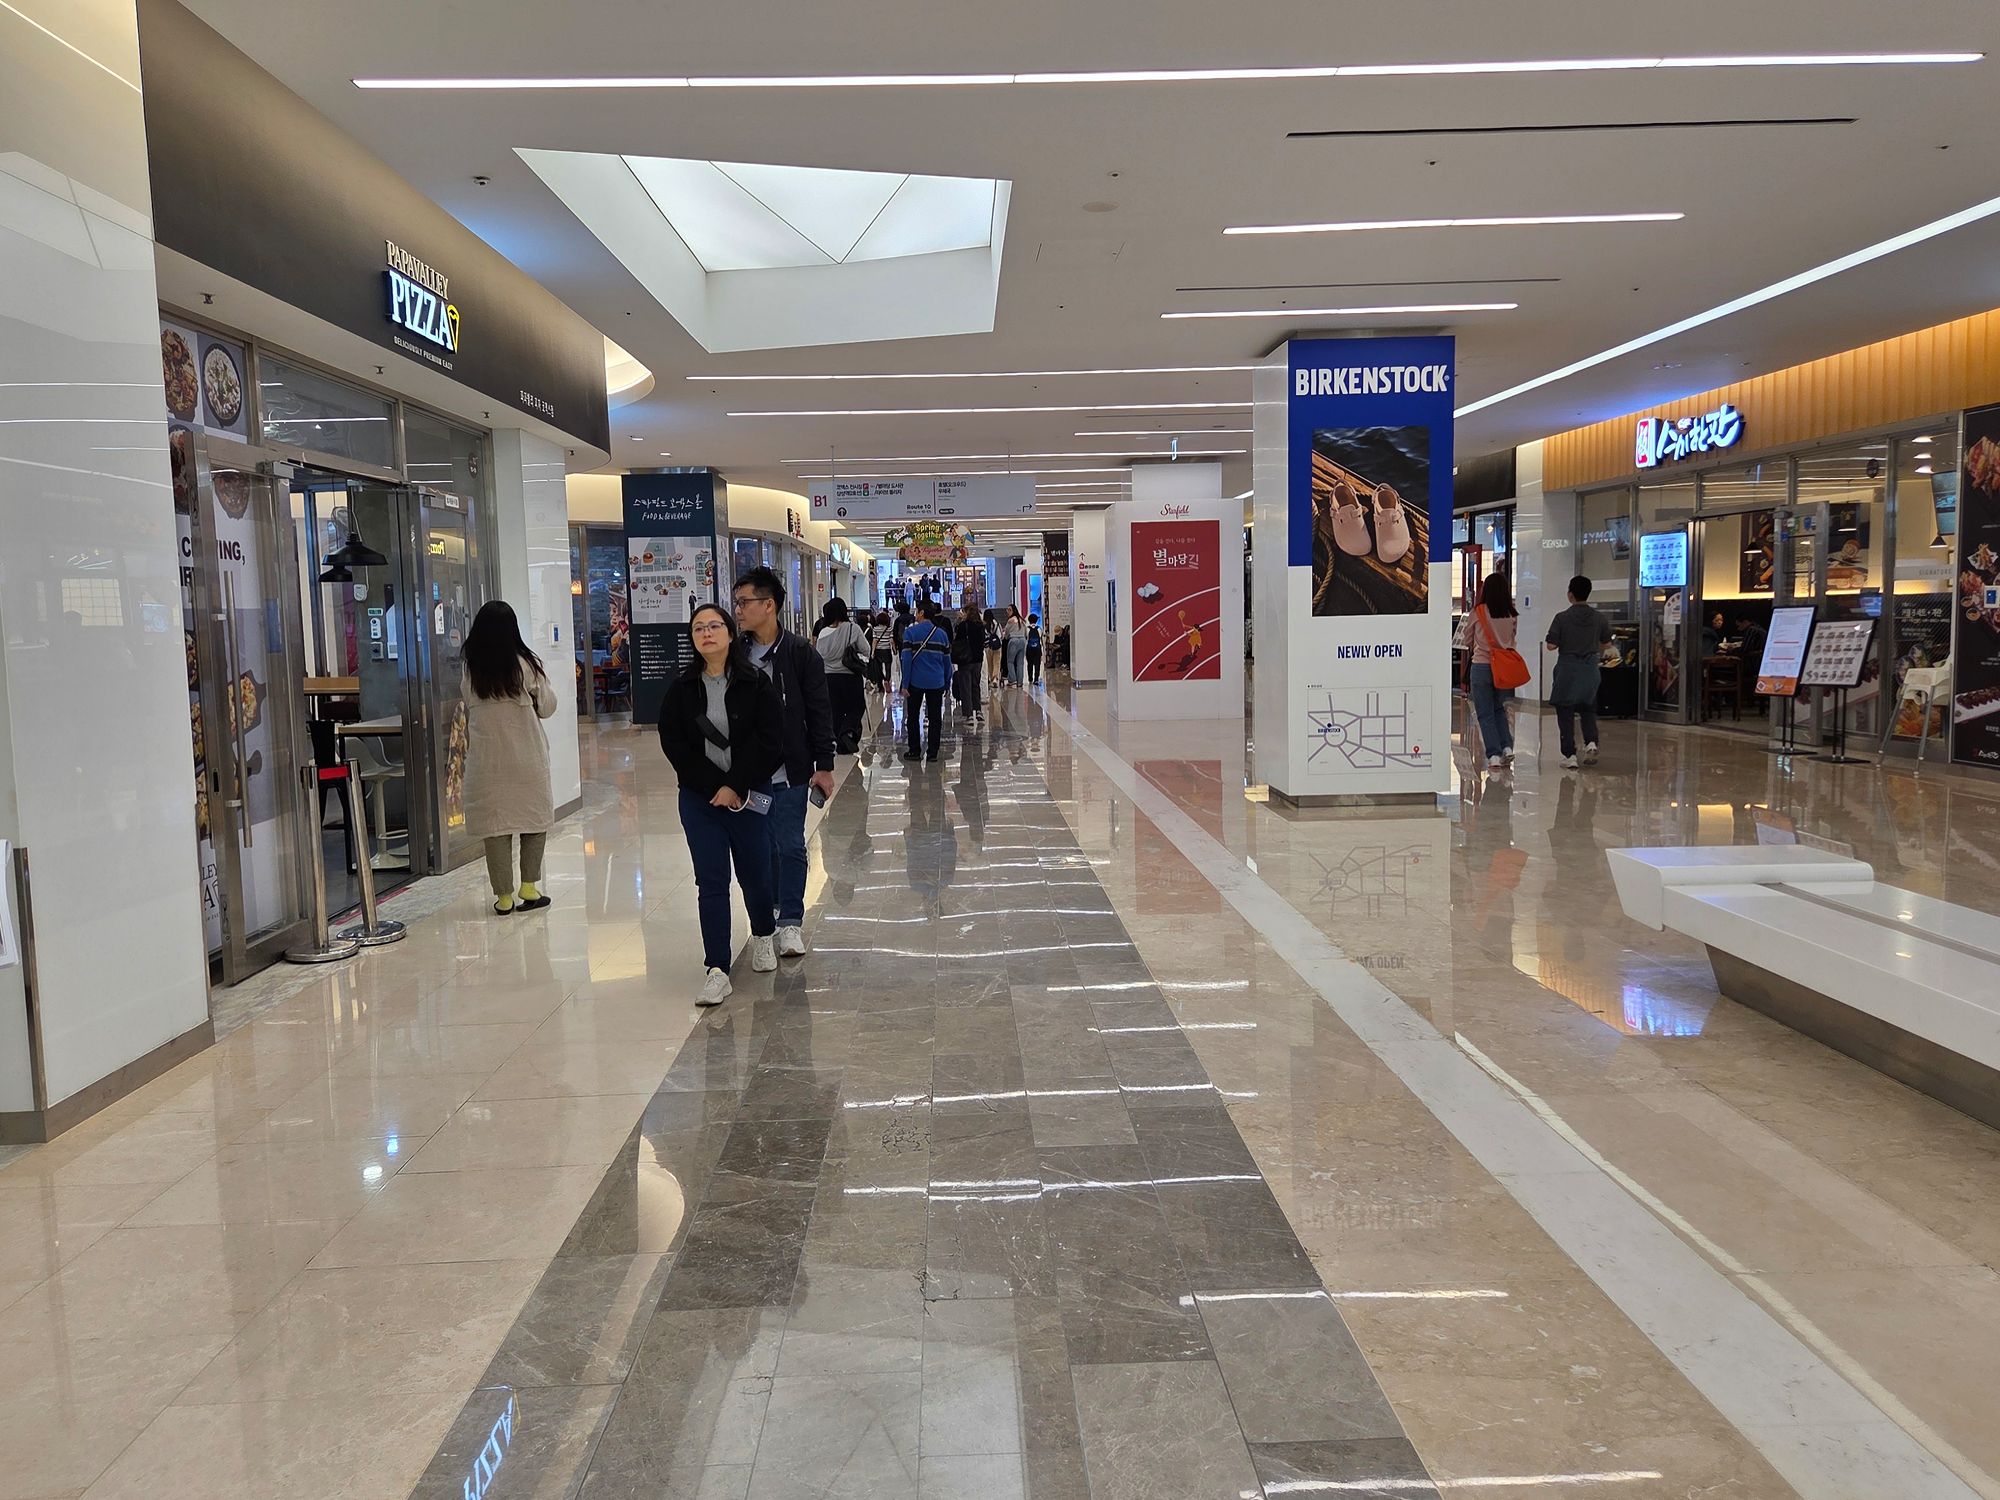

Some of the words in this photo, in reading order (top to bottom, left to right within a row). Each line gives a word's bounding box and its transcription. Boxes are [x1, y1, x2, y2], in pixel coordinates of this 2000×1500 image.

[385, 240, 449, 301] PAPAVALLEY
[389, 269, 454, 351] PIZZA
[1295, 365, 1448, 396] BIRKENSTOCK
[814, 495, 828, 507] B1
[641, 511, 657, 521] FOOD
[1160, 503, 1190, 520] Starfield
[914, 530, 943, 541] Together
[915, 523, 941, 536] Spring
[1337, 645, 1371, 659] NEWLY
[1374, 644, 1403, 658] OPEN
